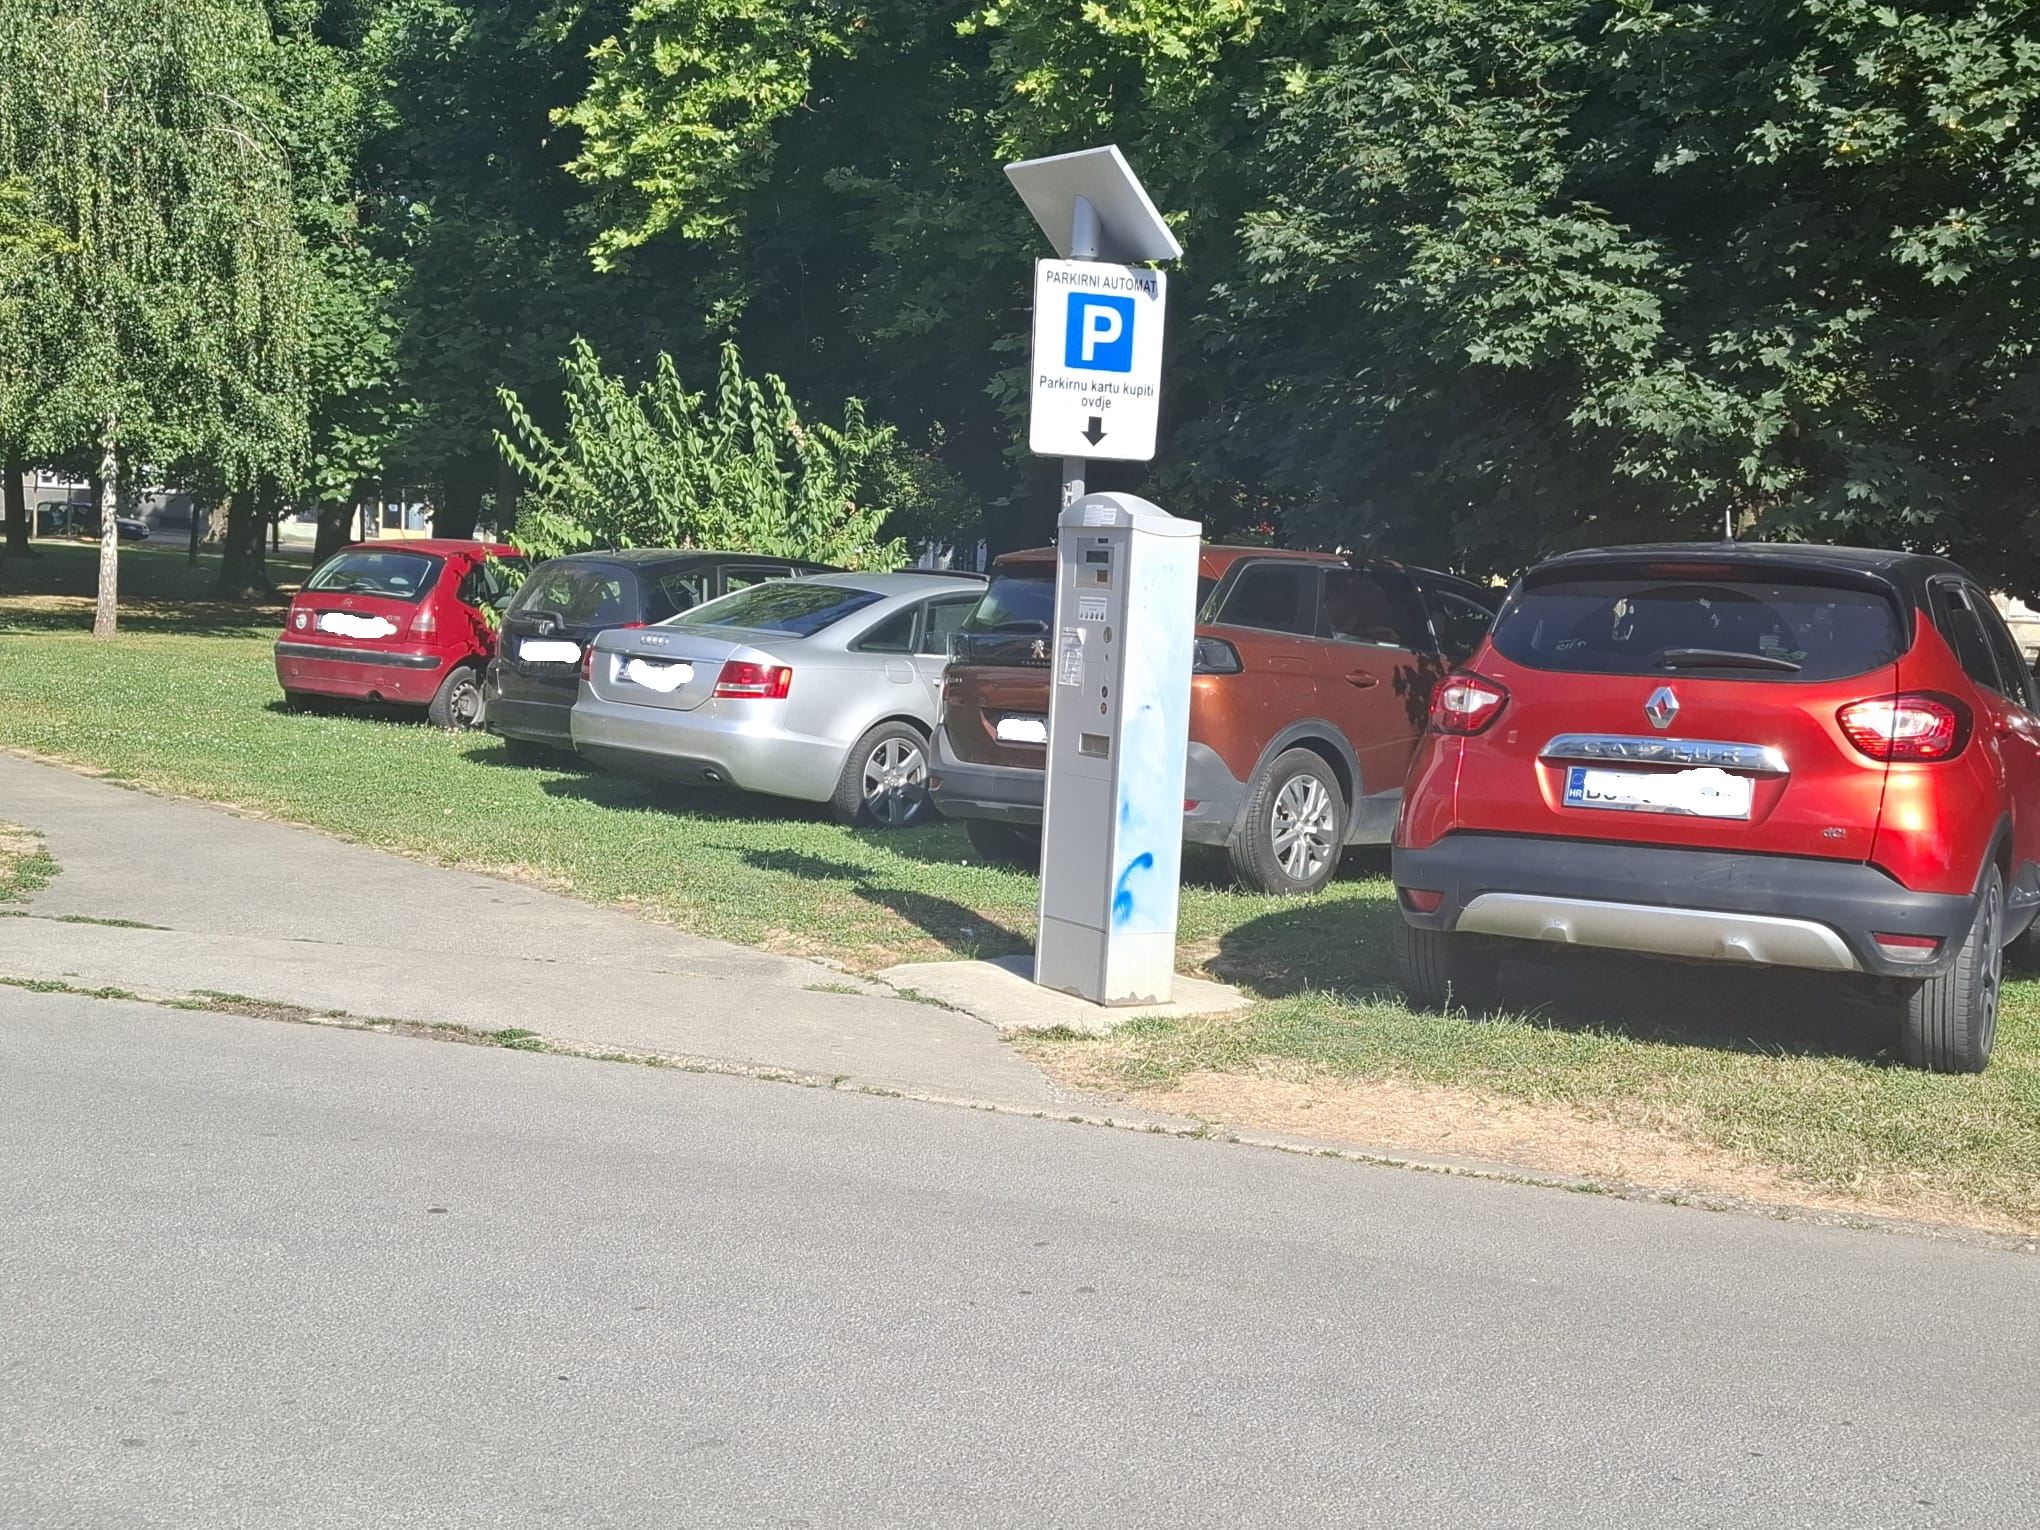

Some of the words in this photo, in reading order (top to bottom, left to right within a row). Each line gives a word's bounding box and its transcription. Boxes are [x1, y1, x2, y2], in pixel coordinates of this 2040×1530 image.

[1046, 270, 1100, 288] PARKIRNI
[1102, 276, 1156, 293] AUTOMAT
[1081, 304, 1123, 361] P
[1039, 375, 1088, 391] Parkirnu
[1091, 380, 1120, 393] kartu
[1123, 382, 1155, 398] kupiti
[1081, 396, 1112, 411] ovdje
[1569, 788, 1582, 798] HR
